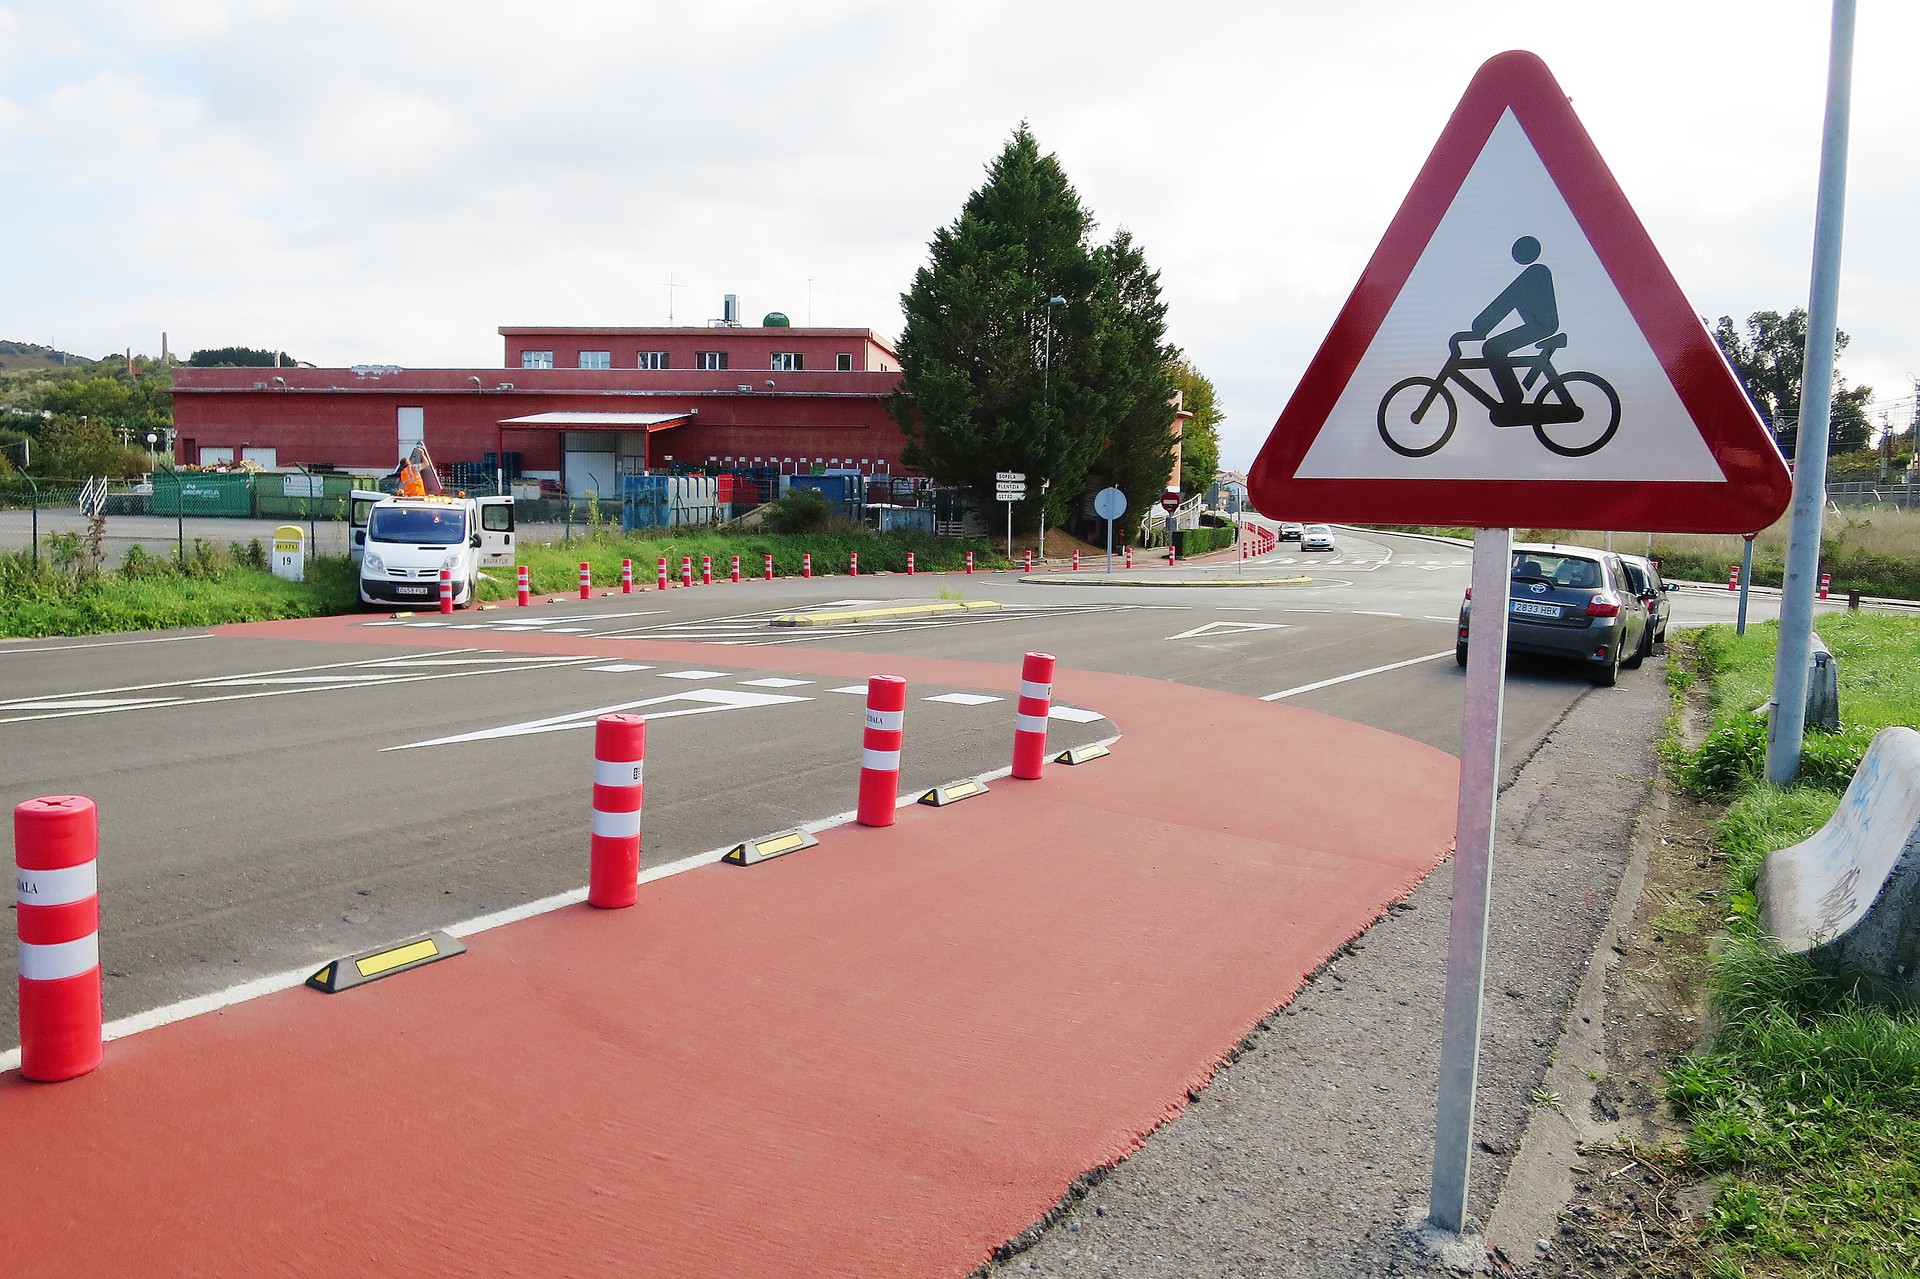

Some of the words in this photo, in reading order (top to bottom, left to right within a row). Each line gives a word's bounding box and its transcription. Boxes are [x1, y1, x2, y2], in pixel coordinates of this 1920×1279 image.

[282, 556, 292, 565] 19
[1516, 604, 1539, 613] 2833
[1541, 606, 1558, 615] HBK
